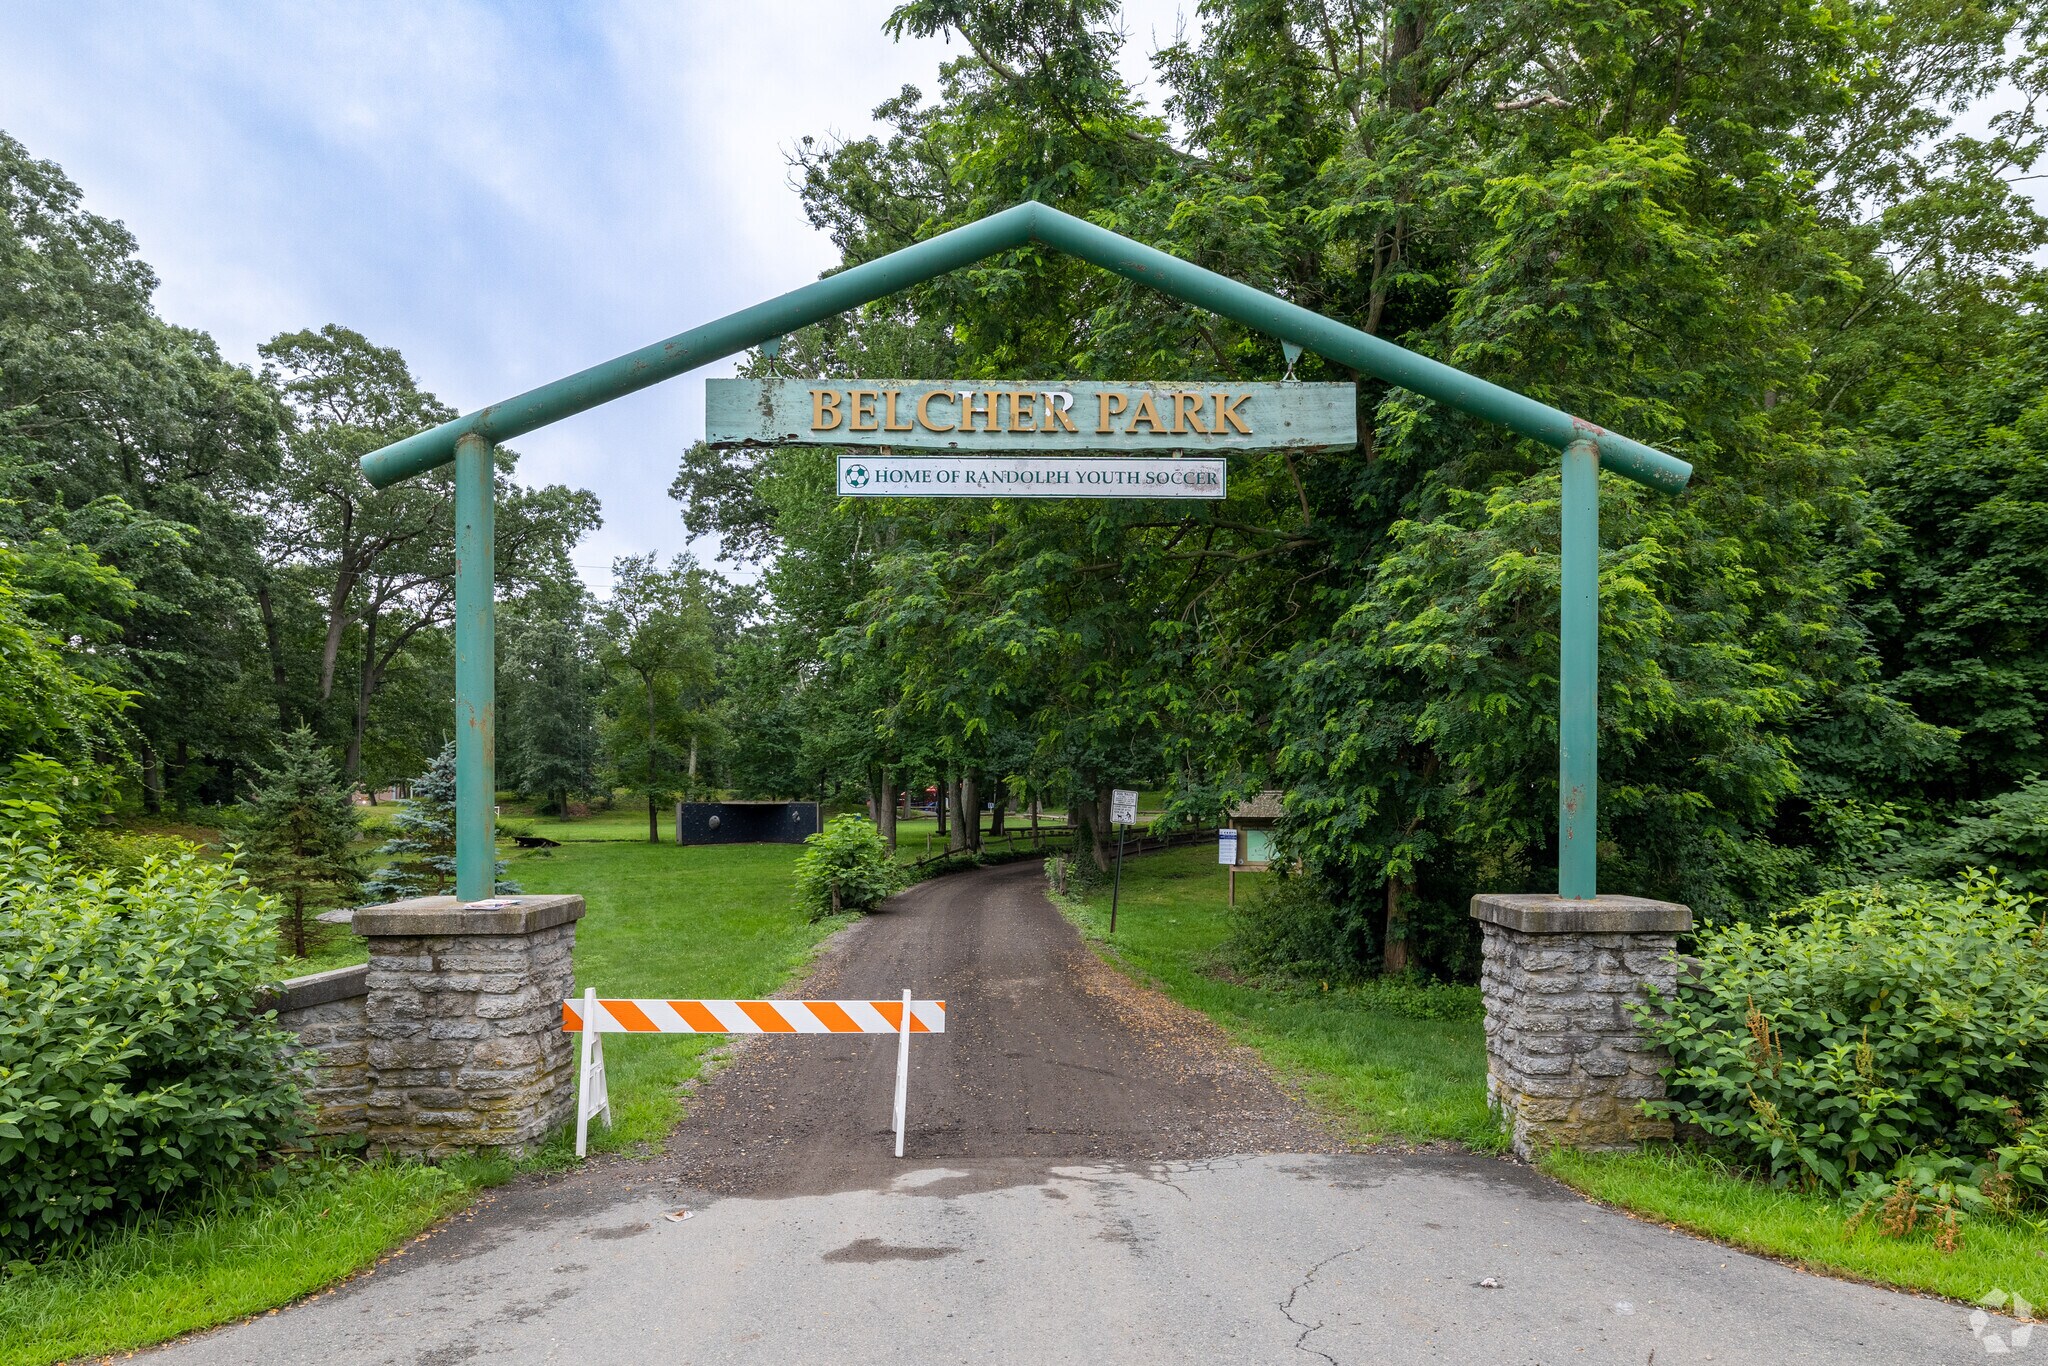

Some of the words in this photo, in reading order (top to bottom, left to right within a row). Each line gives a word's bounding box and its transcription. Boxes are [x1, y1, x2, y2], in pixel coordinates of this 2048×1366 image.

[809, 389, 1079, 433] BELCHER
[1095, 391, 1253, 435] PARK
[875, 469, 932, 483] HOME
[936, 470, 961, 484] OF
[966, 470, 1070, 485] RANDOLPH
[1075, 470, 1140, 485] YOUTH
[1145, 471, 1218, 486] SOCCER
